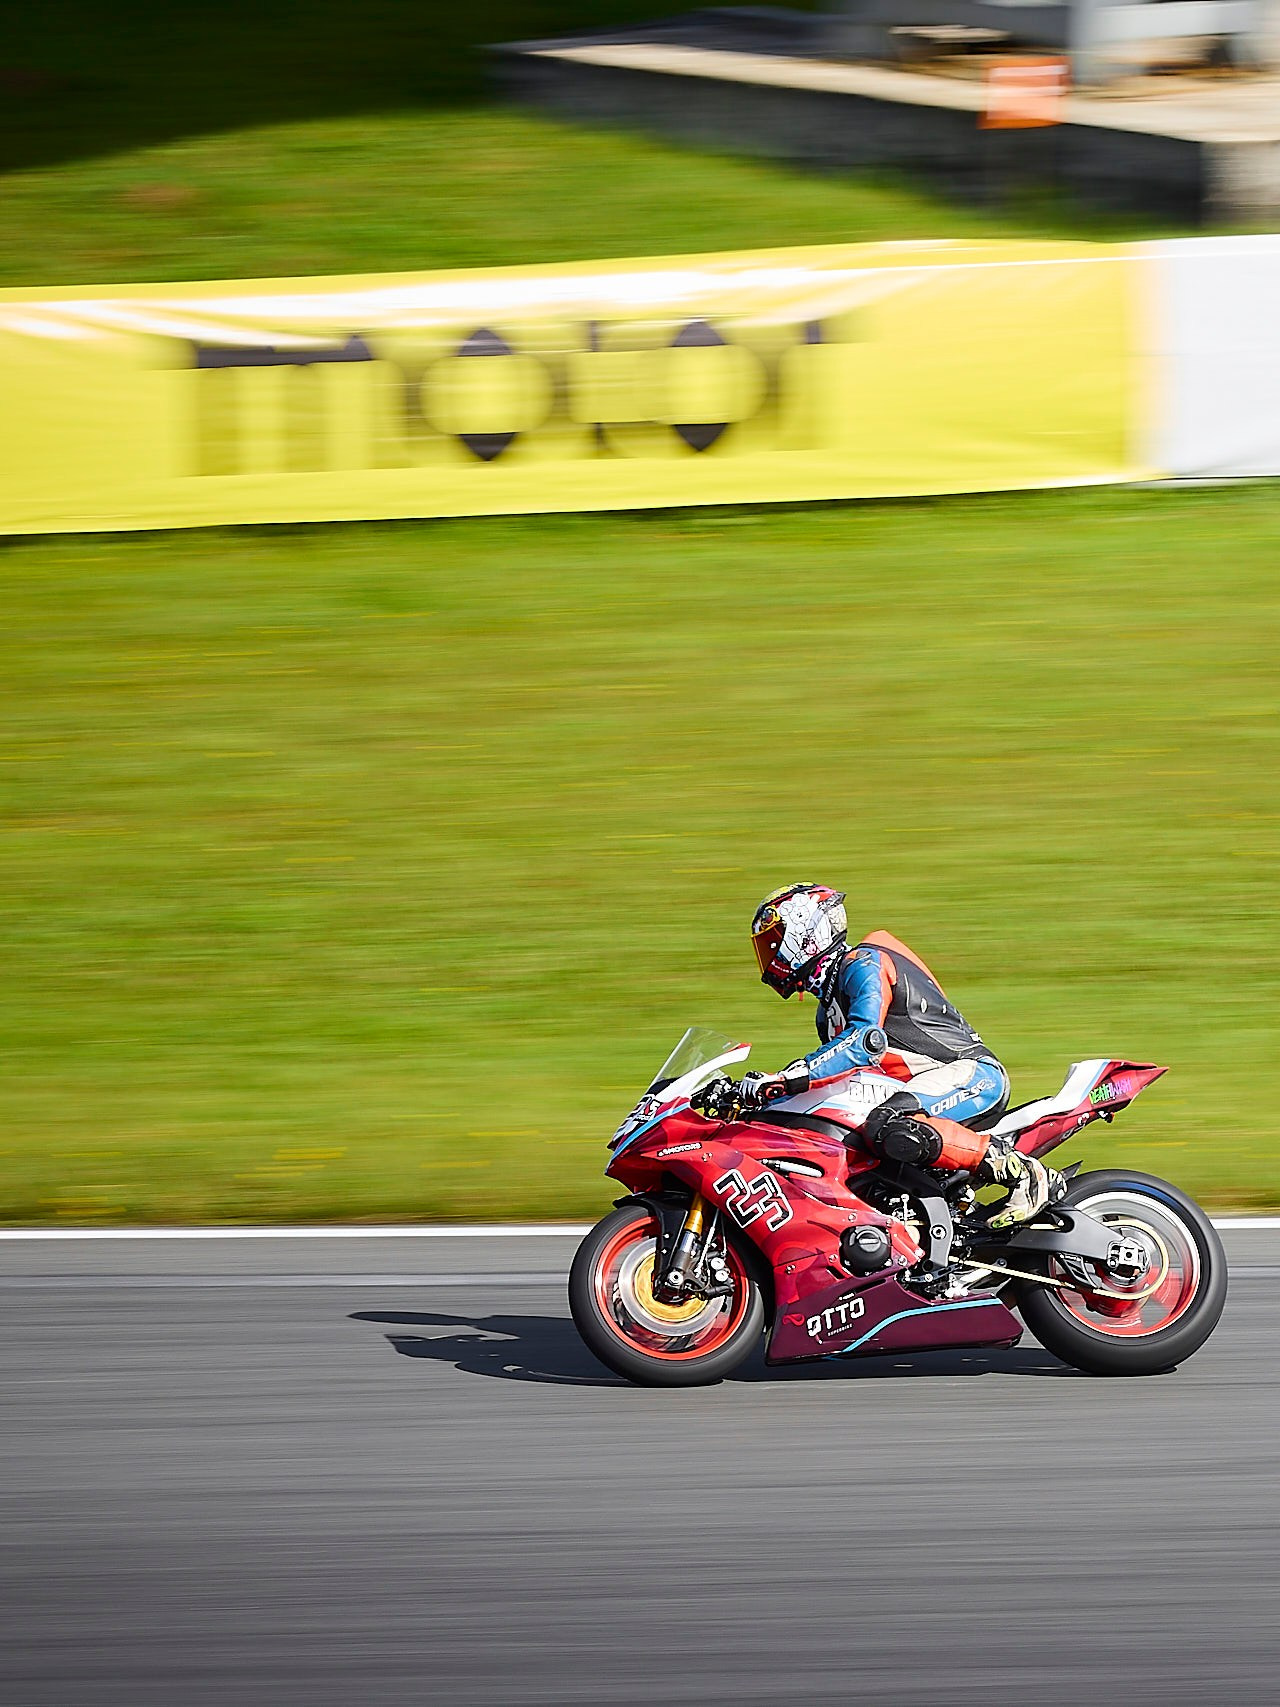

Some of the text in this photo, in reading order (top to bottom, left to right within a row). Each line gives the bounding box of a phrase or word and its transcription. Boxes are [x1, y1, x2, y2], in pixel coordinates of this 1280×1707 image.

[809, 1028, 862, 1070] DAINESE
[930, 1079, 987, 1116] DAINESE
[712, 1168, 794, 1232] 23
[806, 1297, 865, 1337] OTTO
